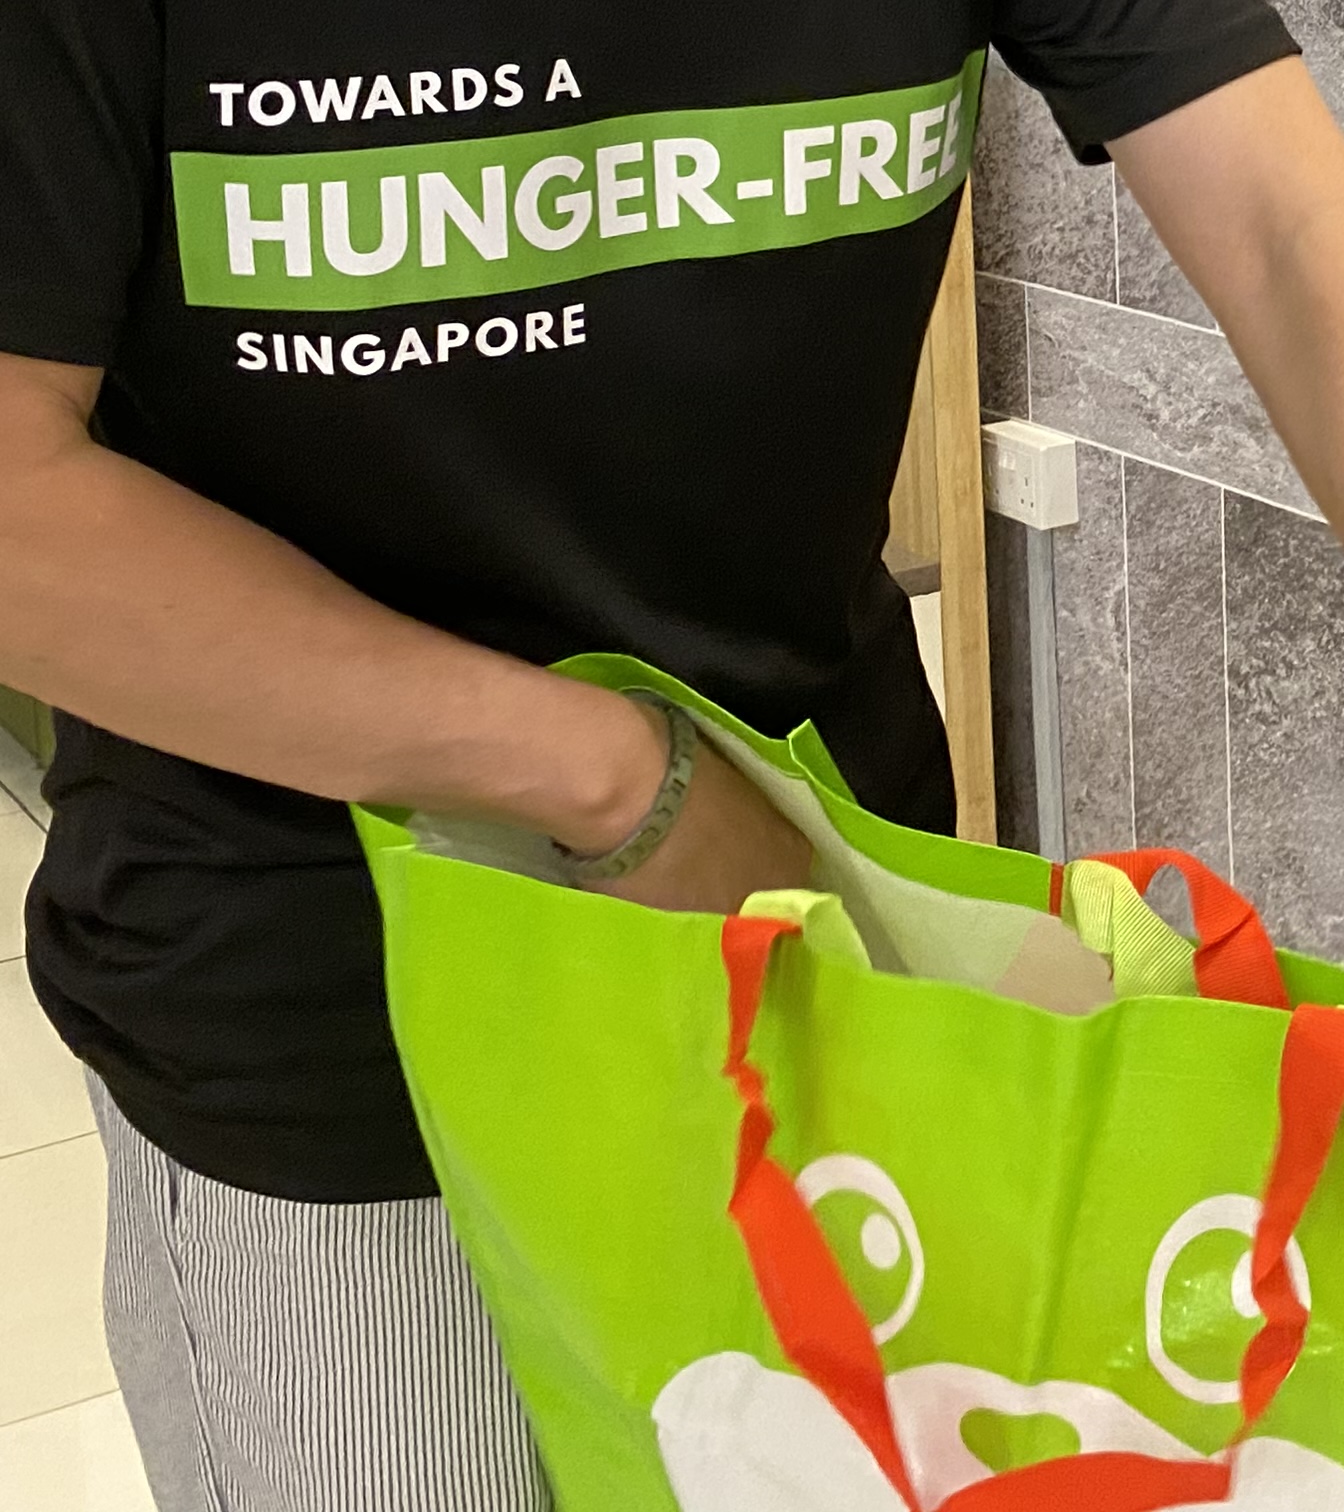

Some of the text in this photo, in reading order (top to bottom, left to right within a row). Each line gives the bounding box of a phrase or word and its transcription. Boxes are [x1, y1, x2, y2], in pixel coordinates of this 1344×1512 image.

[209, 59, 582, 128] TOWARDS A
[223, 90, 963, 278] HUNGER-FREE
[236, 303, 588, 377] SINGAPORE
